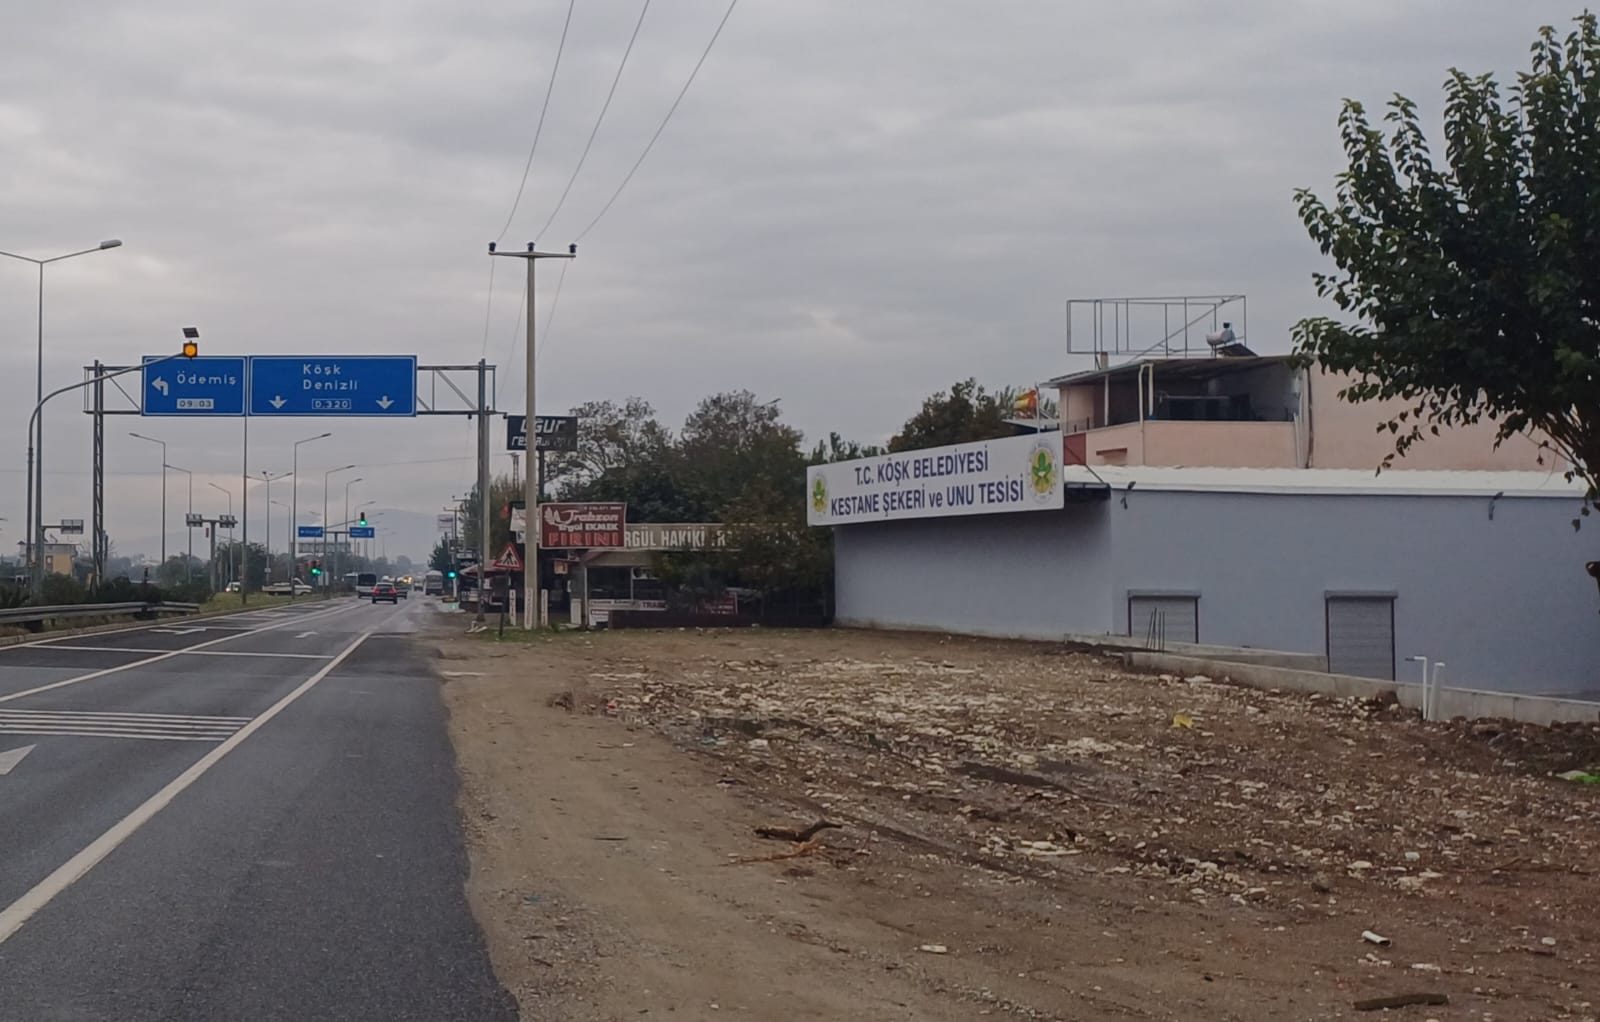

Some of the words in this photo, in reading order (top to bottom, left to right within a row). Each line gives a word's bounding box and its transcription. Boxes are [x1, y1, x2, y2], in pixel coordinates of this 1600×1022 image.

[302, 363, 341, 376] Köşk
[176, 370, 236, 385] Ödemiş
[302, 379, 358, 391] Denizli
[854, 465, 875, 486] T.C.
[877, 457, 910, 487] KÖŞK
[913, 444, 988, 479] BELEDİYESİ
[831, 493, 880, 517] KESTANE
[882, 483, 926, 517] ŞEKERİ
[928, 491, 943, 507] ve
[946, 484, 975, 507] UNU
[978, 473, 1024, 504] TESİSİ
